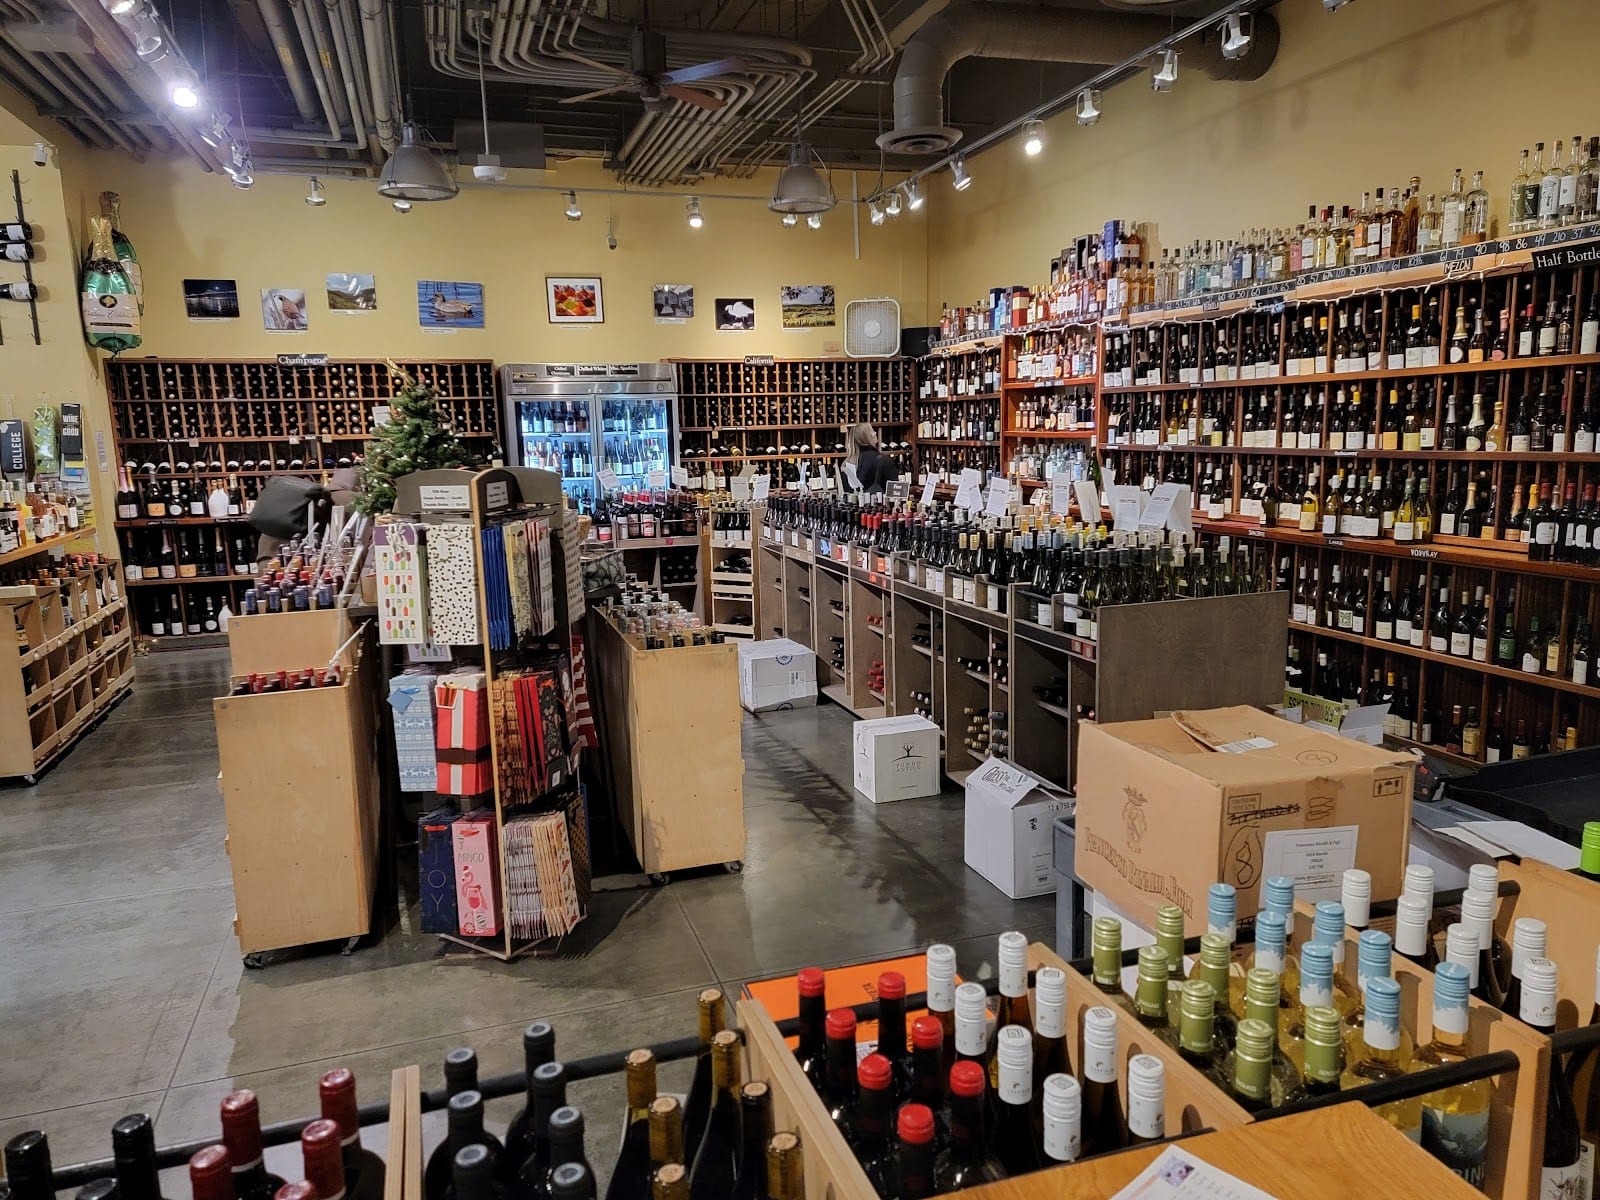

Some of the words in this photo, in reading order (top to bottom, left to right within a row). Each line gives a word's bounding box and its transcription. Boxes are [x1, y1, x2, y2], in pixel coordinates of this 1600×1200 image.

[1516, 239, 1528, 250] 86
[1552, 232, 1566, 242] 210
[1571, 229, 1584, 240] 37
[1536, 252, 1562, 268] Half
[745, 356, 774, 367] California
[62, 414, 79, 423] WINE
[62, 427, 79, 436] GOOD
[11, 431, 23, 470] COLLEGE
[428, 842, 447, 912] JOY
